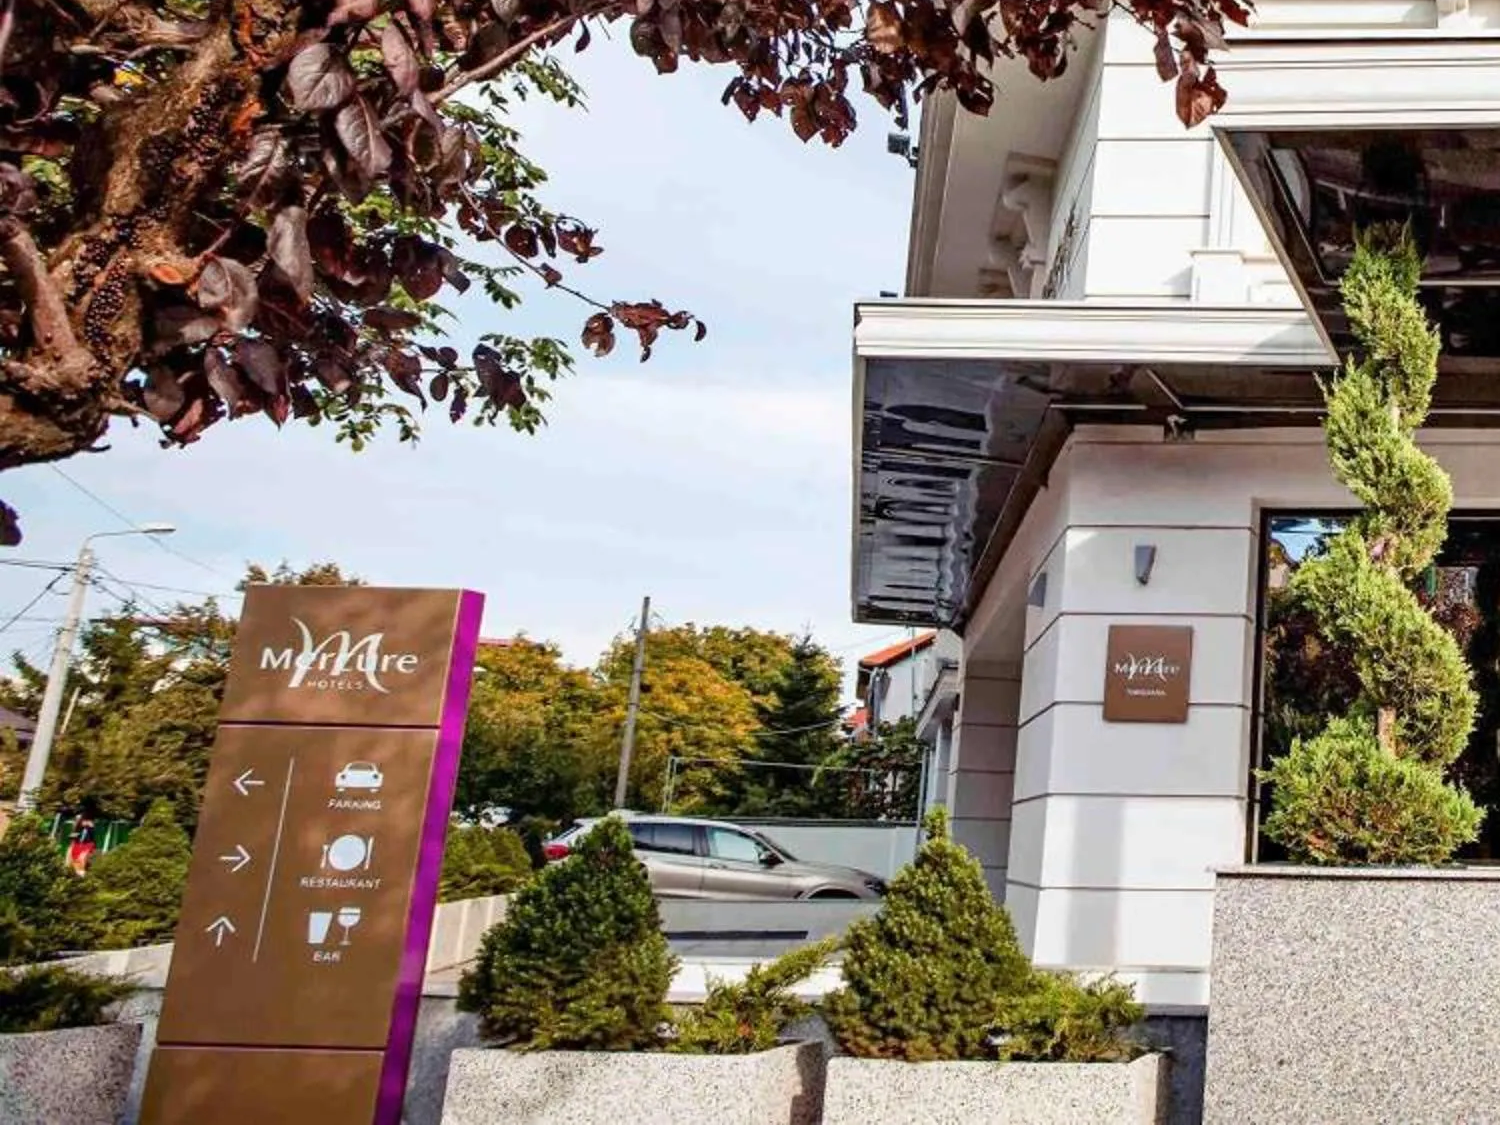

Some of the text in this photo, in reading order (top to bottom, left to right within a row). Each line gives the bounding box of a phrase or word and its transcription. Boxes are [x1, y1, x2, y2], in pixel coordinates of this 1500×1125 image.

[306, 678, 363, 691] HOTELS
[327, 797, 383, 811] PARKING
[299, 875, 382, 890] RESTAURANT
[312, 949, 342, 963] BAR
